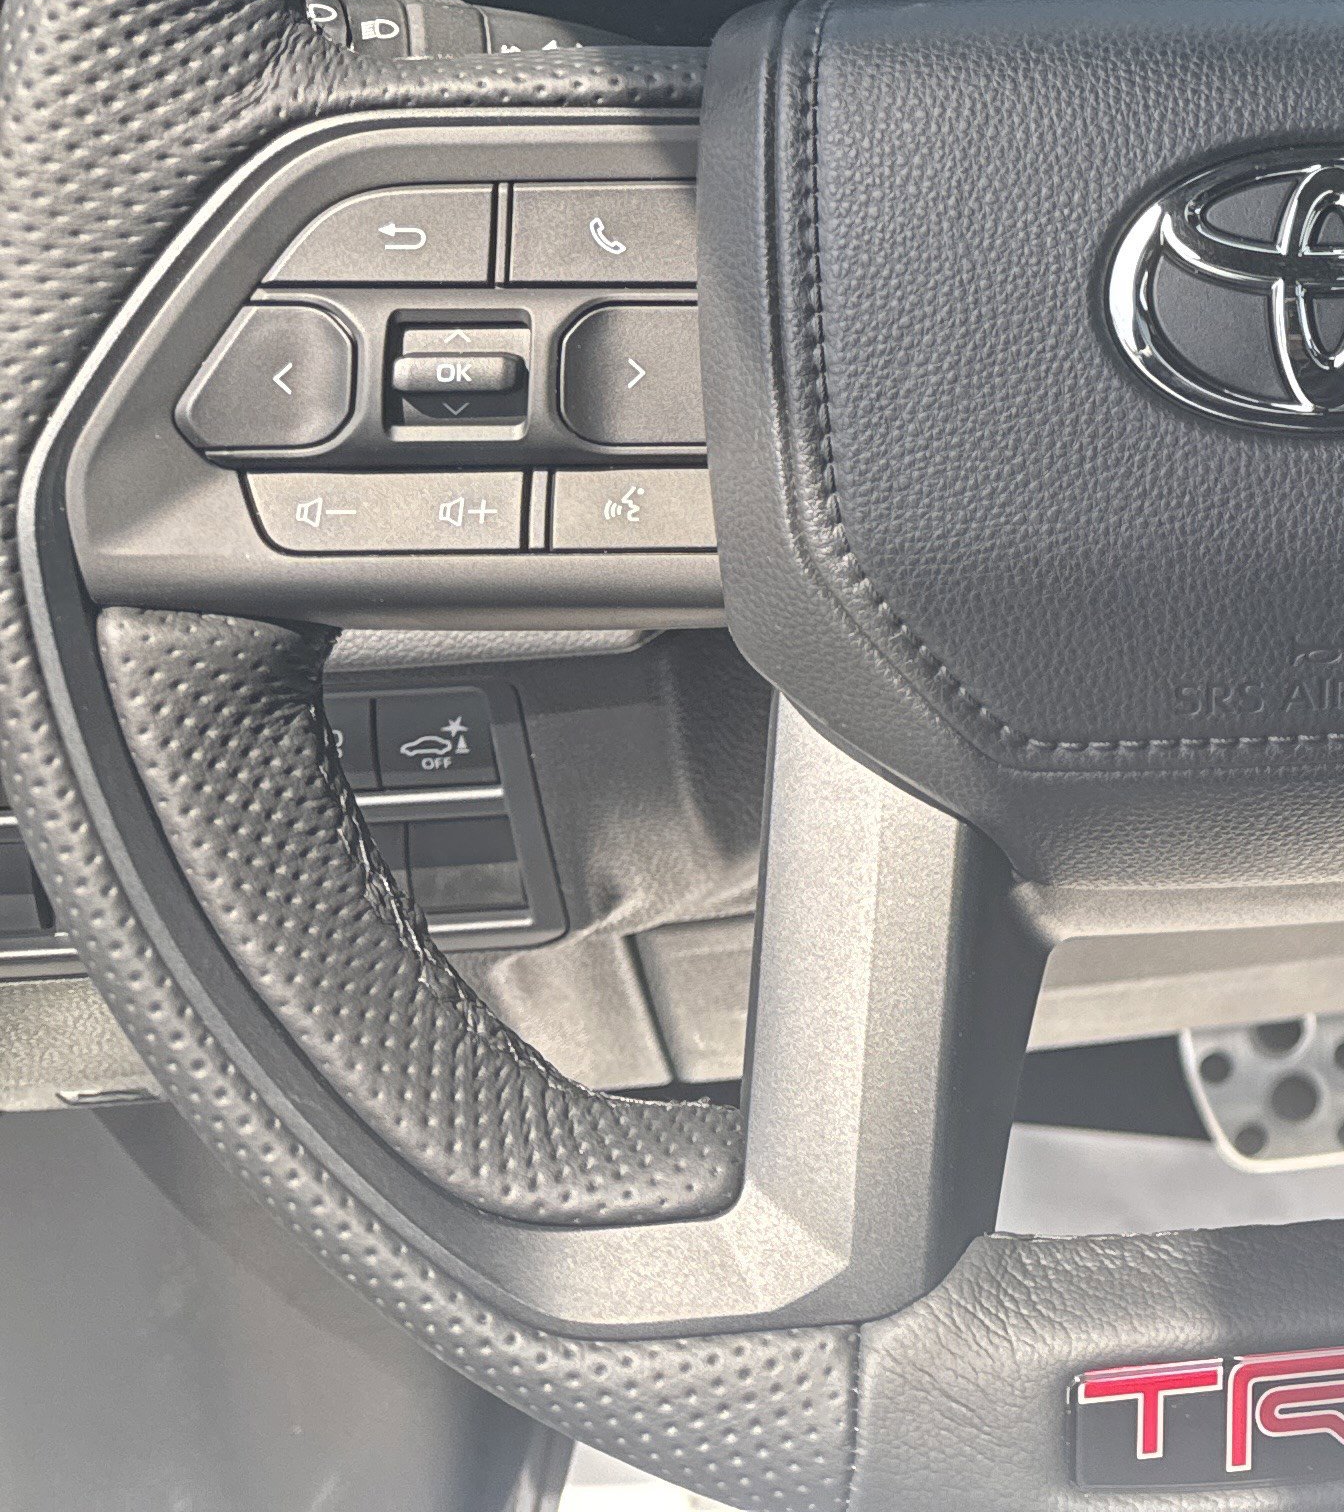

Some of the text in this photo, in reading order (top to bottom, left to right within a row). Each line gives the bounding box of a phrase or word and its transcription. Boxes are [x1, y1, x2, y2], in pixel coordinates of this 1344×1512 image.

[435, 362, 473, 384] OK
[1180, 681, 1265, 717] SRS
[421, 756, 453, 771] OFF
